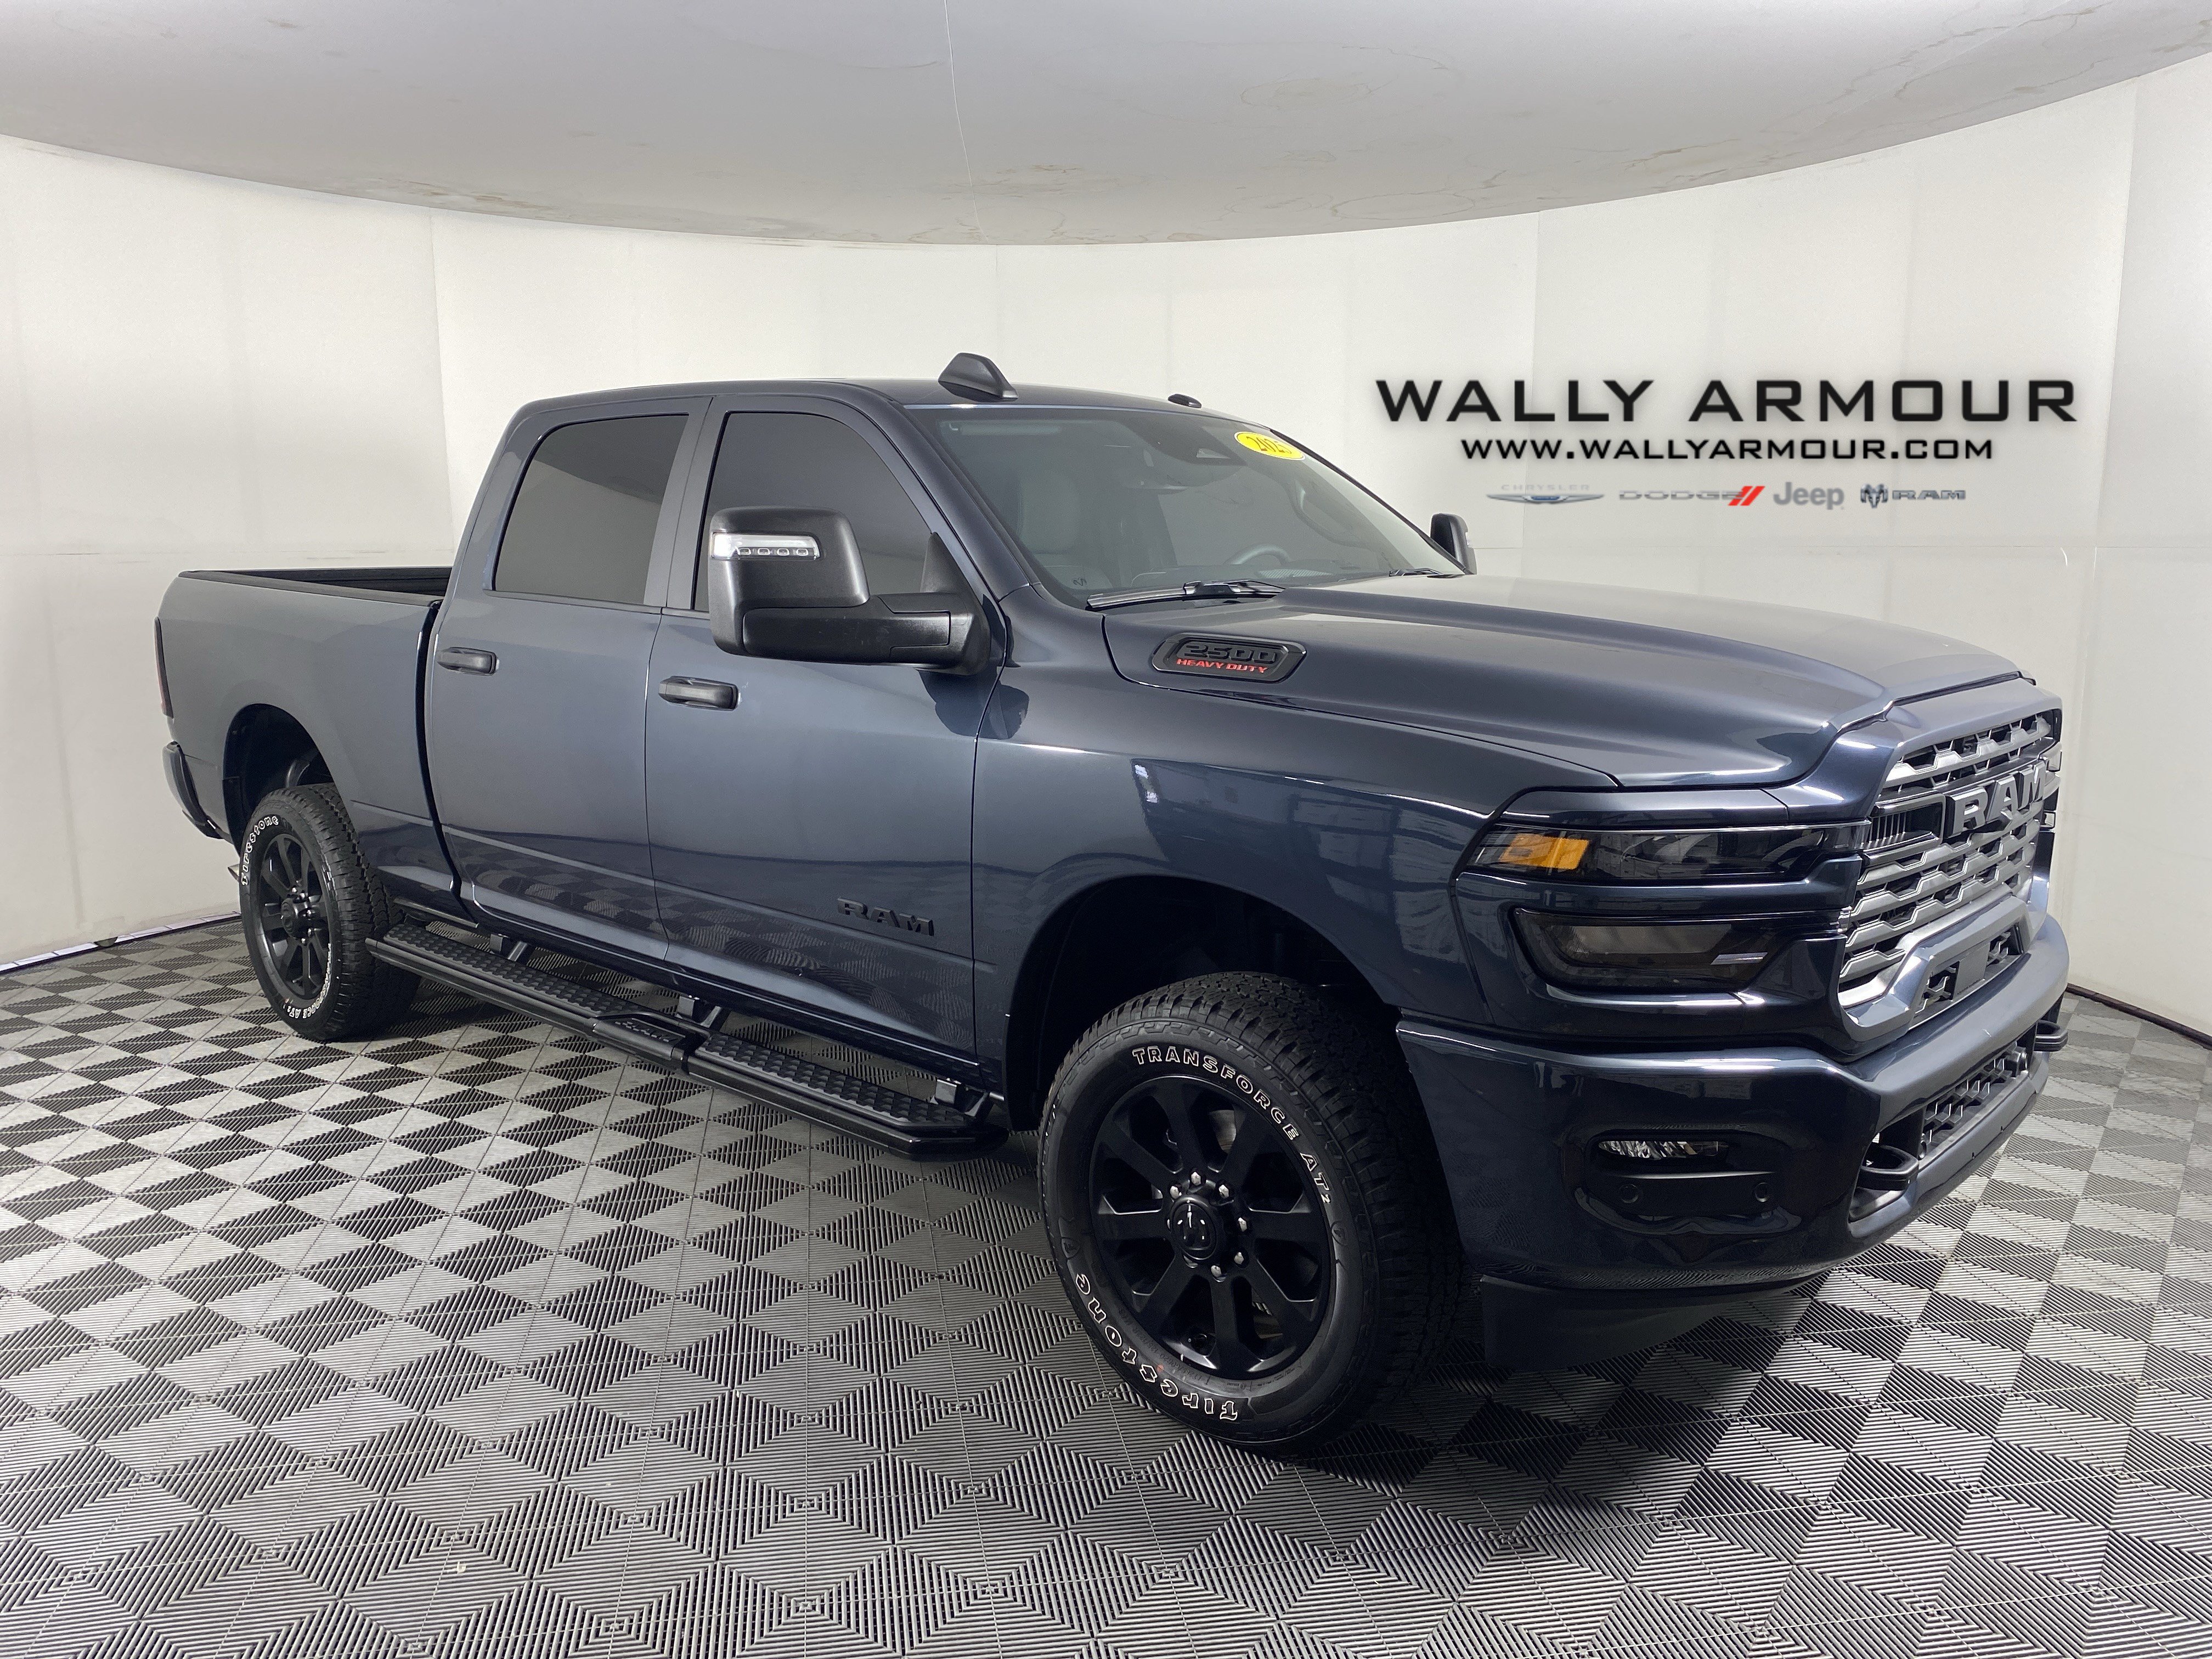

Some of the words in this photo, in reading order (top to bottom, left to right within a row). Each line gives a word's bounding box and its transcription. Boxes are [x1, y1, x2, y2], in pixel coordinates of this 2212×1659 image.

[1176, 658, 1225, 669] HEAVY
[1225, 663, 1268, 674] DUTY
[1184, 644, 1278, 664] 2500
[1948, 760, 2046, 837] RAM
[837, 896, 935, 936] RAM
[1132, 1045, 1300, 1141] TRANSFORCE
